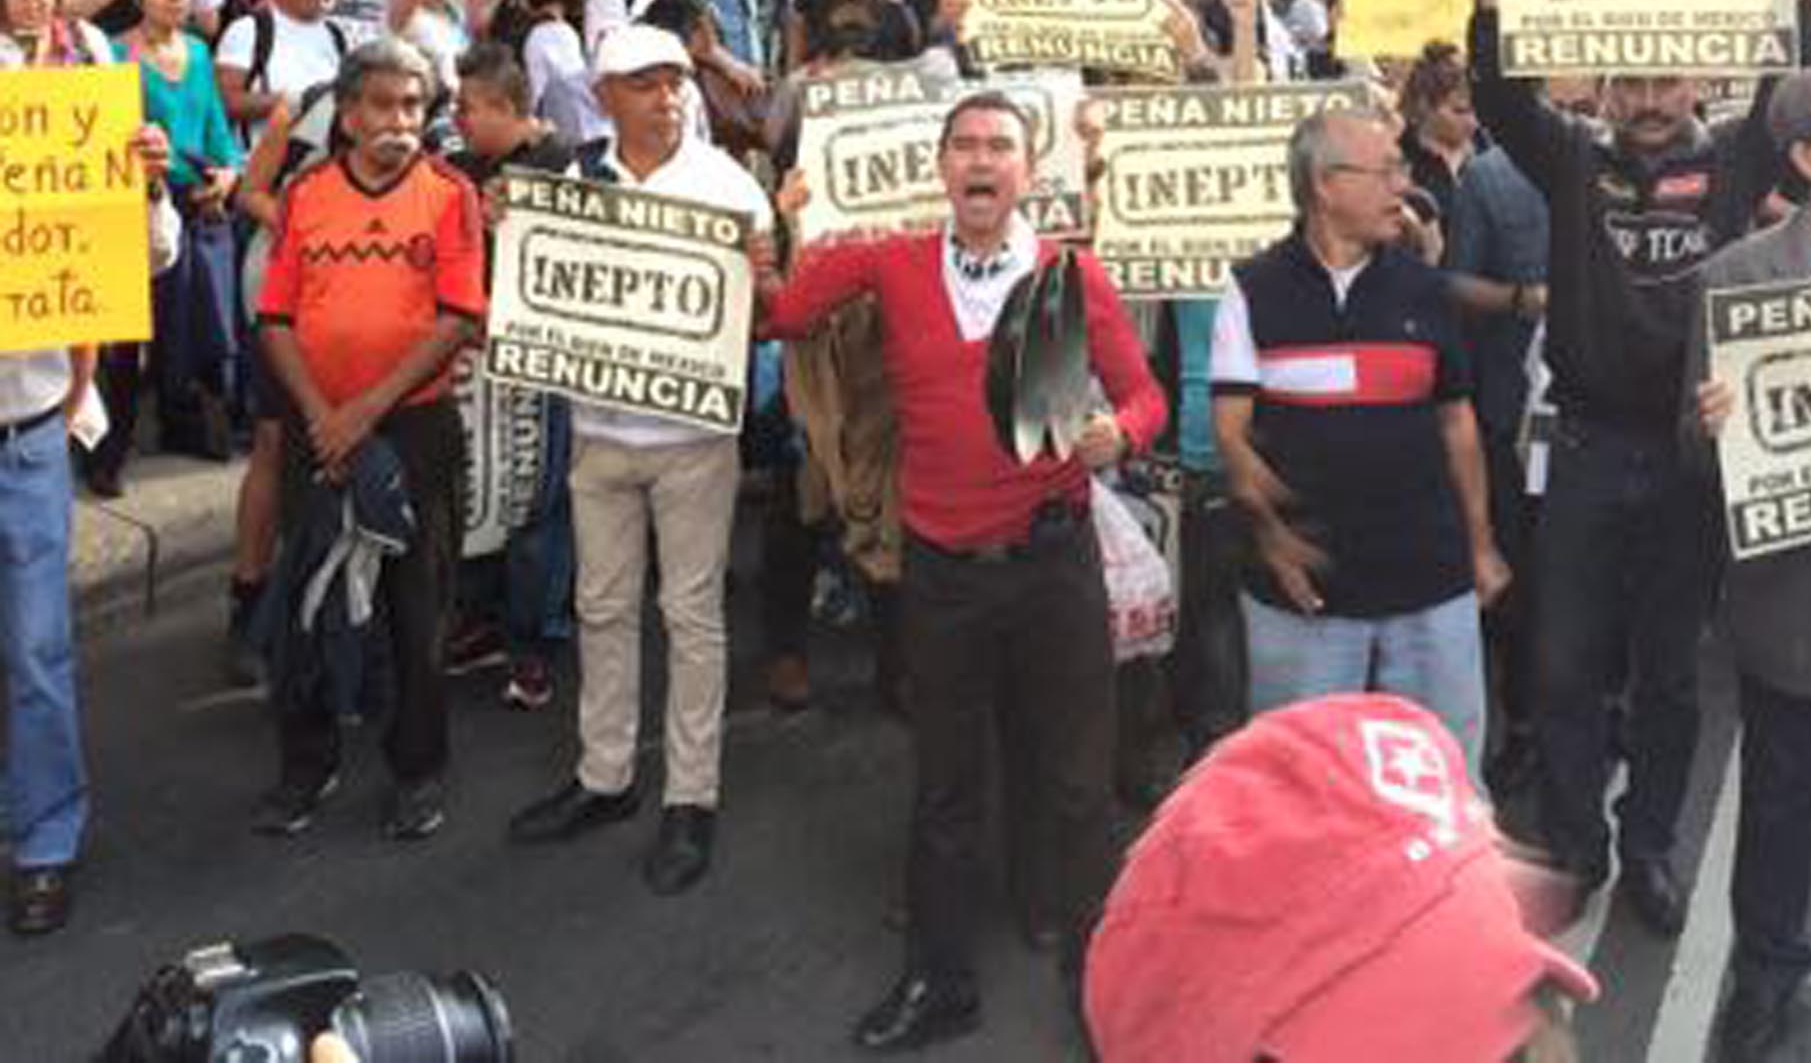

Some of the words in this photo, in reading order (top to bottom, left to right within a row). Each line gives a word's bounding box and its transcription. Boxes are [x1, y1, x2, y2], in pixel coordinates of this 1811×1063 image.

[976, 37, 1177, 75] RENUNCIA
[1513, 31, 1788, 65] RENUNCIA
[805, 69, 925, 111] PEÑA
[0, 150, 88, 193] eña
[1124, 162, 1288, 211] INEPT
[507, 178, 607, 218] PEÑA
[618, 196, 740, 245] NIETO
[532, 255, 713, 318] INEPTO
[1105, 258, 1228, 289] RENU
[495, 341, 732, 423] RENUNCIA
